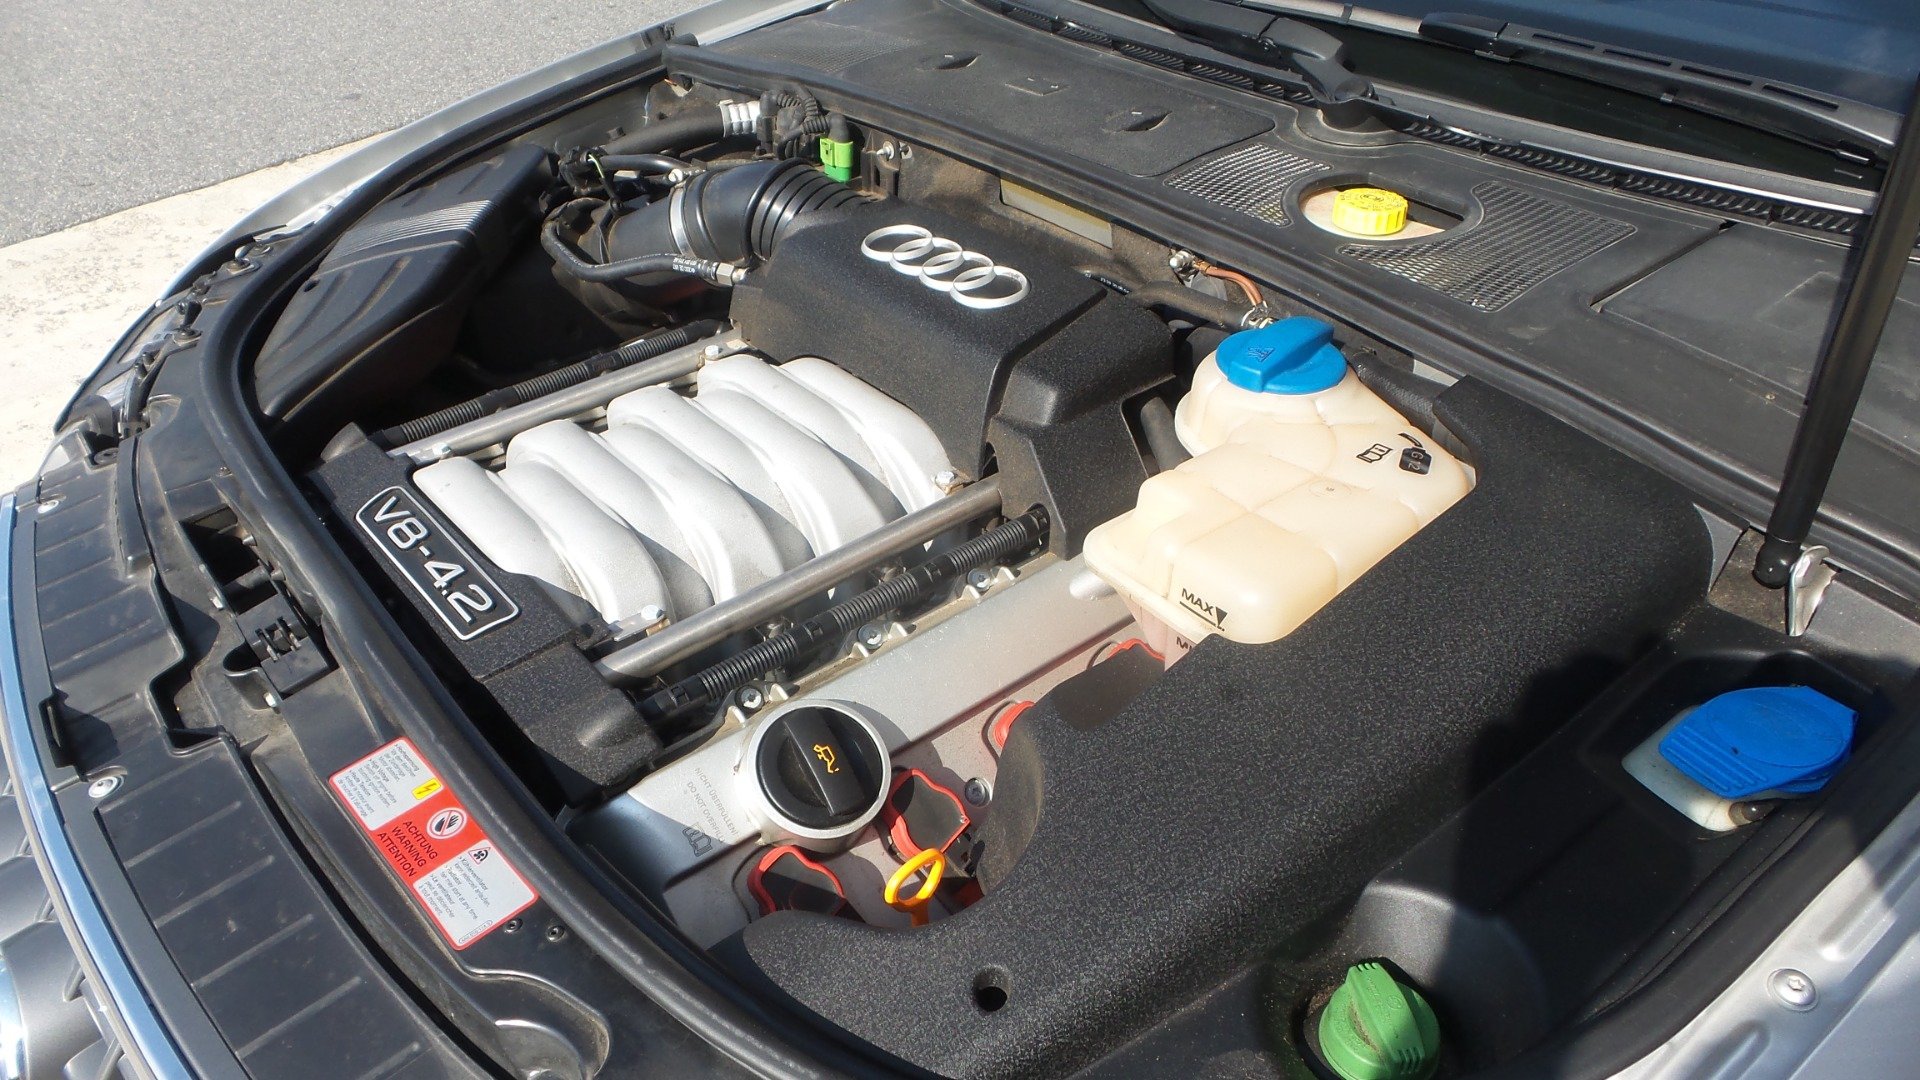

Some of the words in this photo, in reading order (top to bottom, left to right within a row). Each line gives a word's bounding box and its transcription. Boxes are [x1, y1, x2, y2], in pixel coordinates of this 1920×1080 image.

[373, 495, 493, 623] V8-4.2
[1181, 587, 1214, 616] MAX
[687, 781, 696, 793] DO
[694, 794, 706, 809] NOT
[695, 767, 711, 789] NICHT
[378, 831, 416, 877] ATTENTION
[391, 827, 426, 867] WARNING
[403, 820, 437, 859] ACHTUNG
